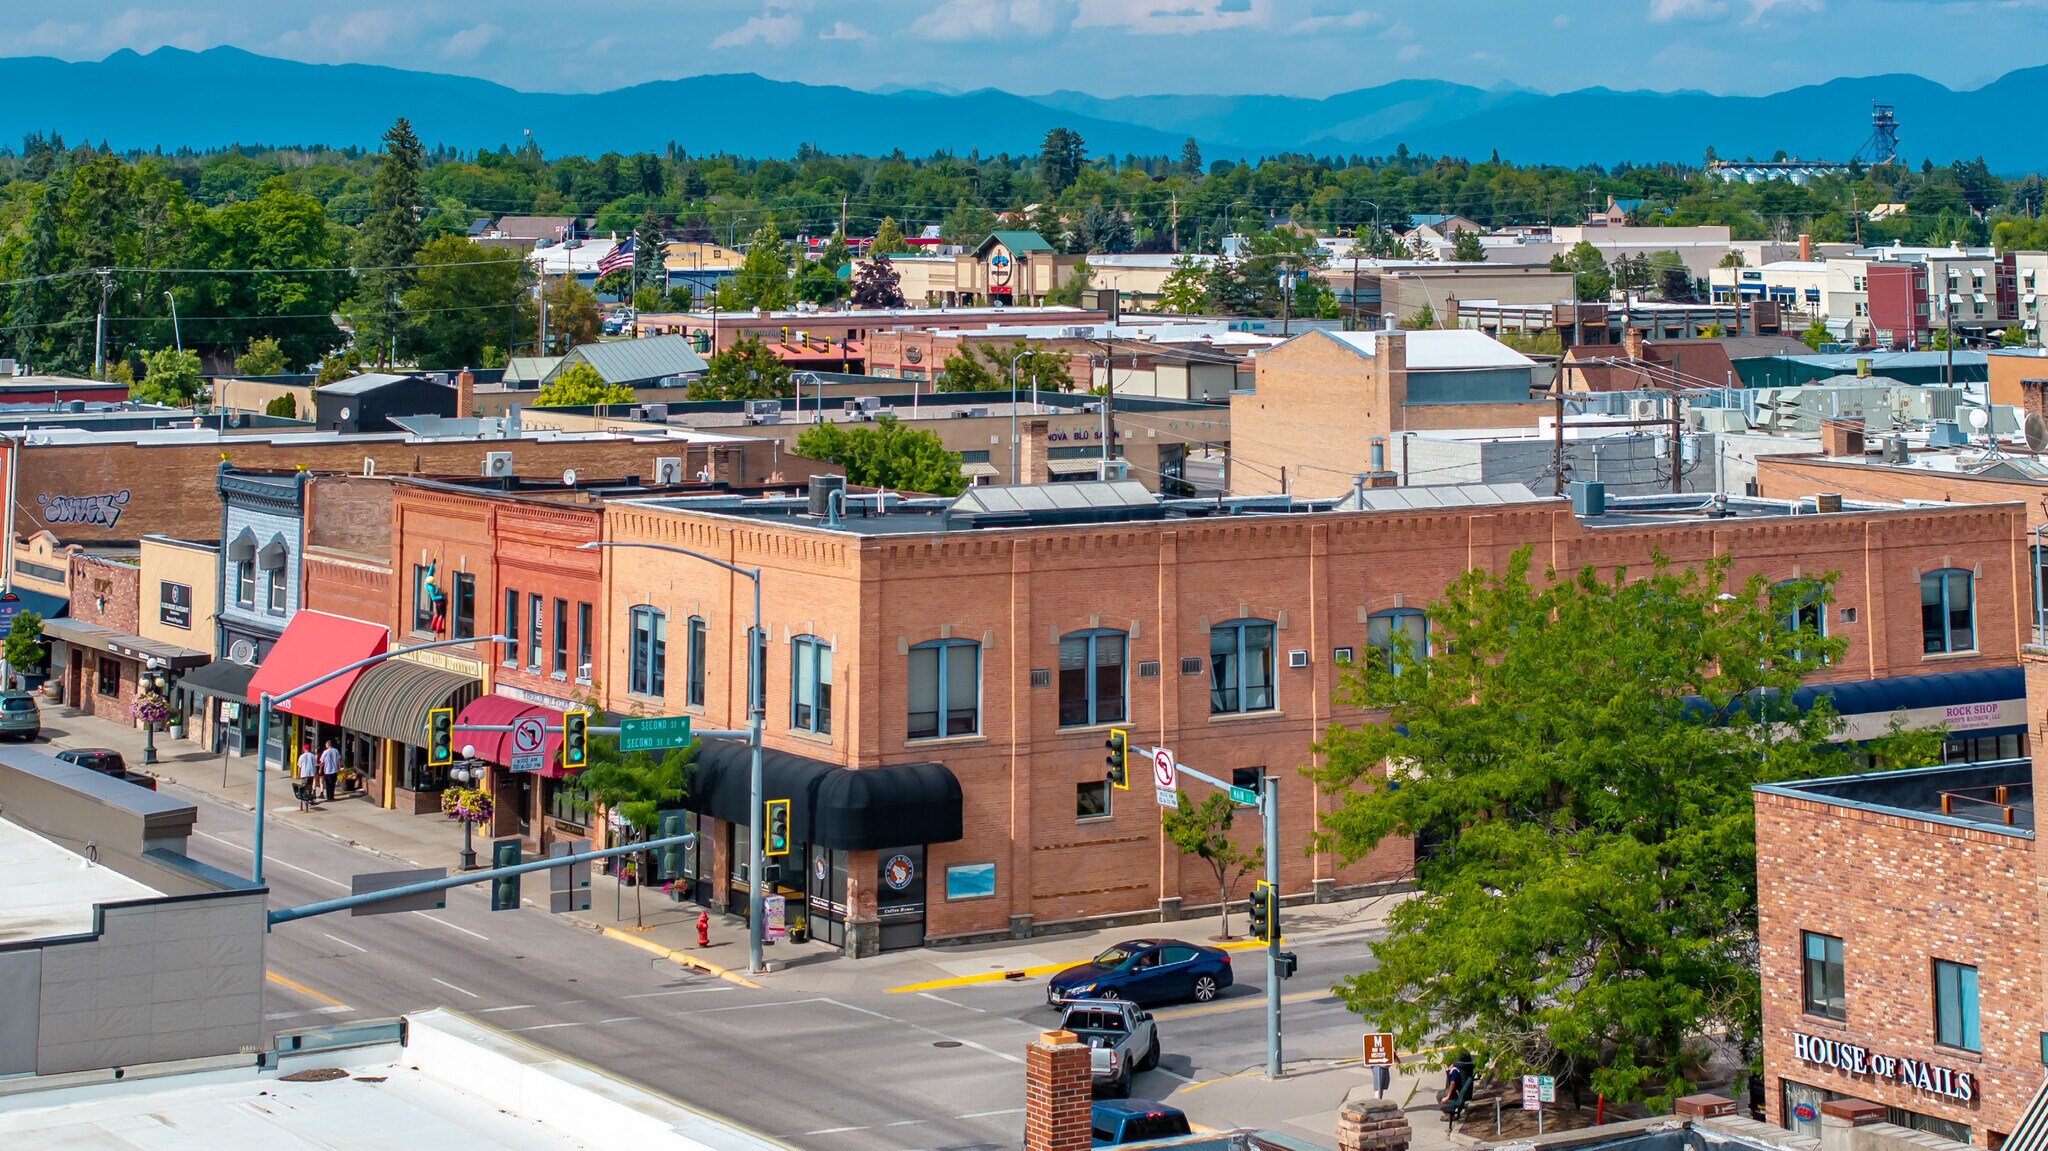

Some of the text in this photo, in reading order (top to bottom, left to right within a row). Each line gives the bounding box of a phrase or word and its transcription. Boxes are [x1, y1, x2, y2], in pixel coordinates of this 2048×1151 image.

[1048, 432, 1068, 441] NOVA
[1094, 430, 1120, 440] SAN
[1946, 704, 1998, 716] ROCK SHOP
[641, 720, 666, 731] SECOND
[627, 738, 652, 748] SECOND
[1233, 790, 1244, 799] MAIN
[1374, 1036, 1382, 1047] M
[1792, 1032, 1972, 1100] HOUSE OF NAILS
